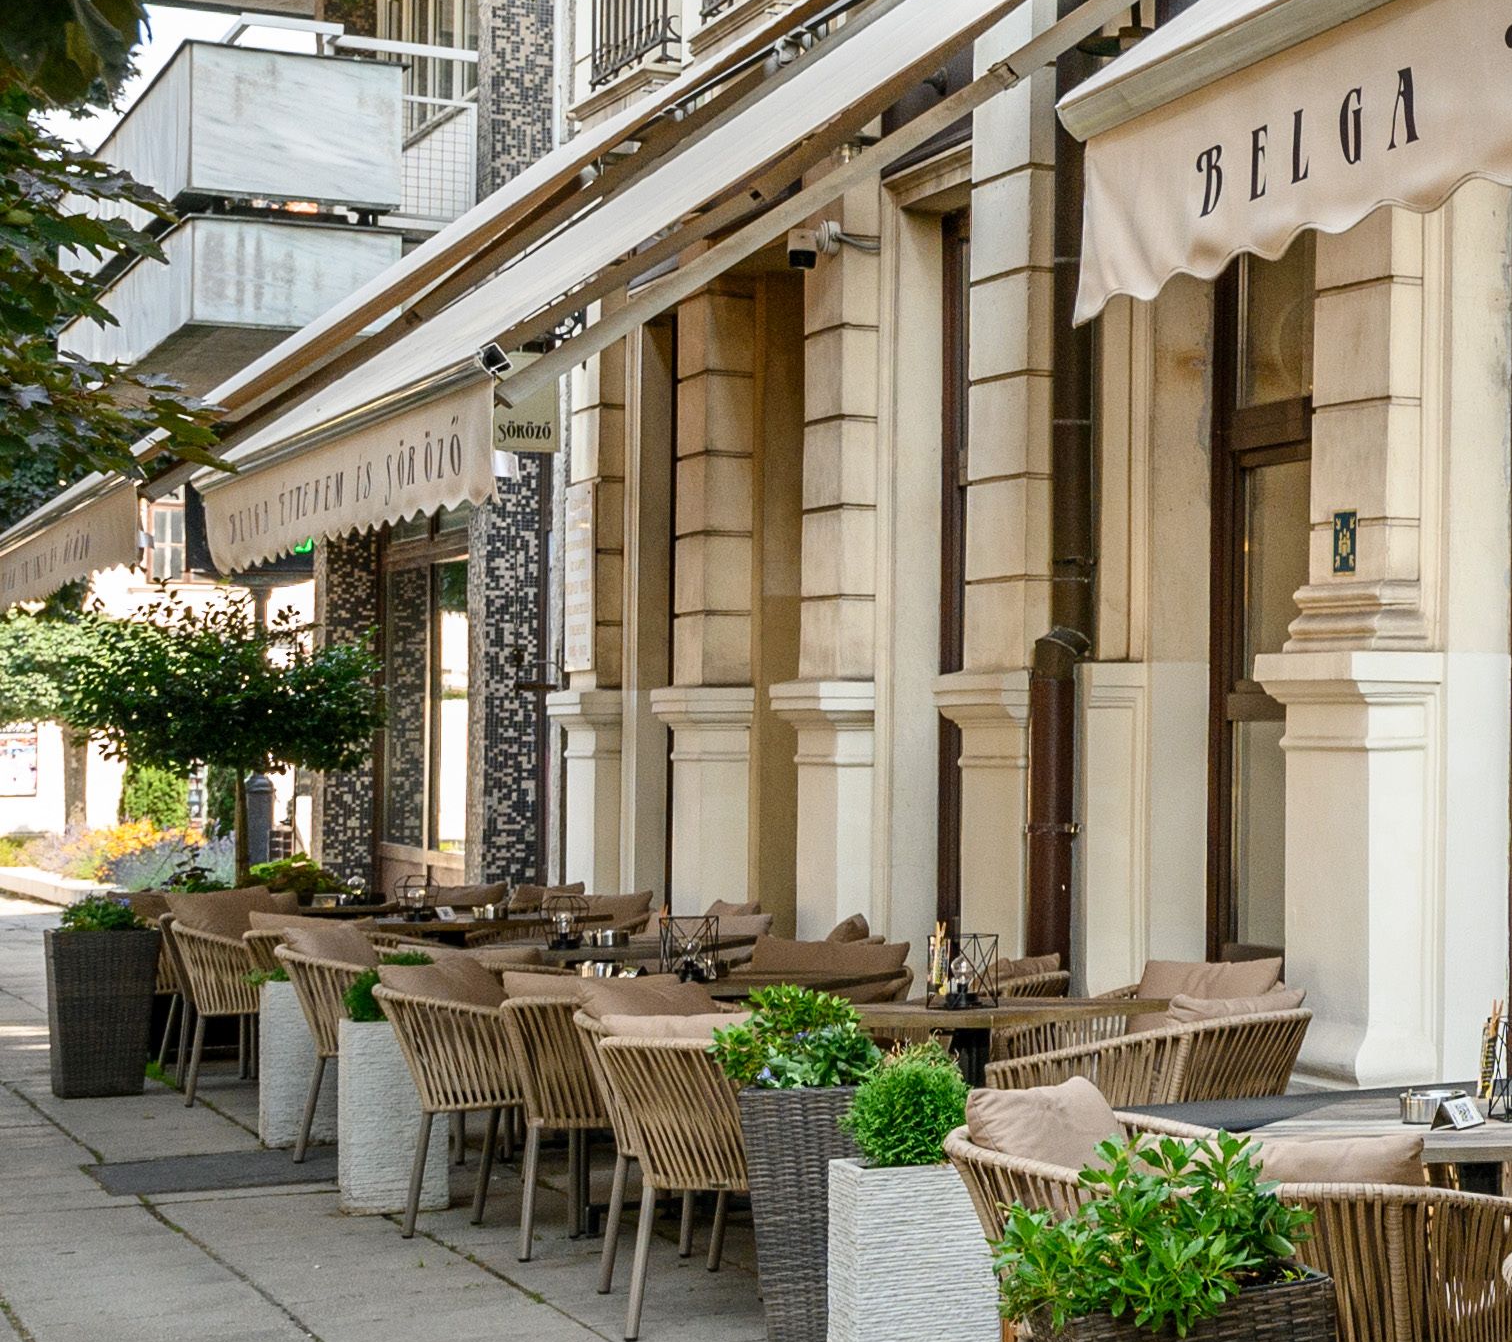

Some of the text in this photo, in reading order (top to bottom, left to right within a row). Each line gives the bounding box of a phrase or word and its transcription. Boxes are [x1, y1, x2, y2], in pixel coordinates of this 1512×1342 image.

[1195, 66, 1420, 218] BELGA
[385, 415, 461, 506] SÖRÖZŐ
[498, 420, 551, 442] SÖRÖZŐ
